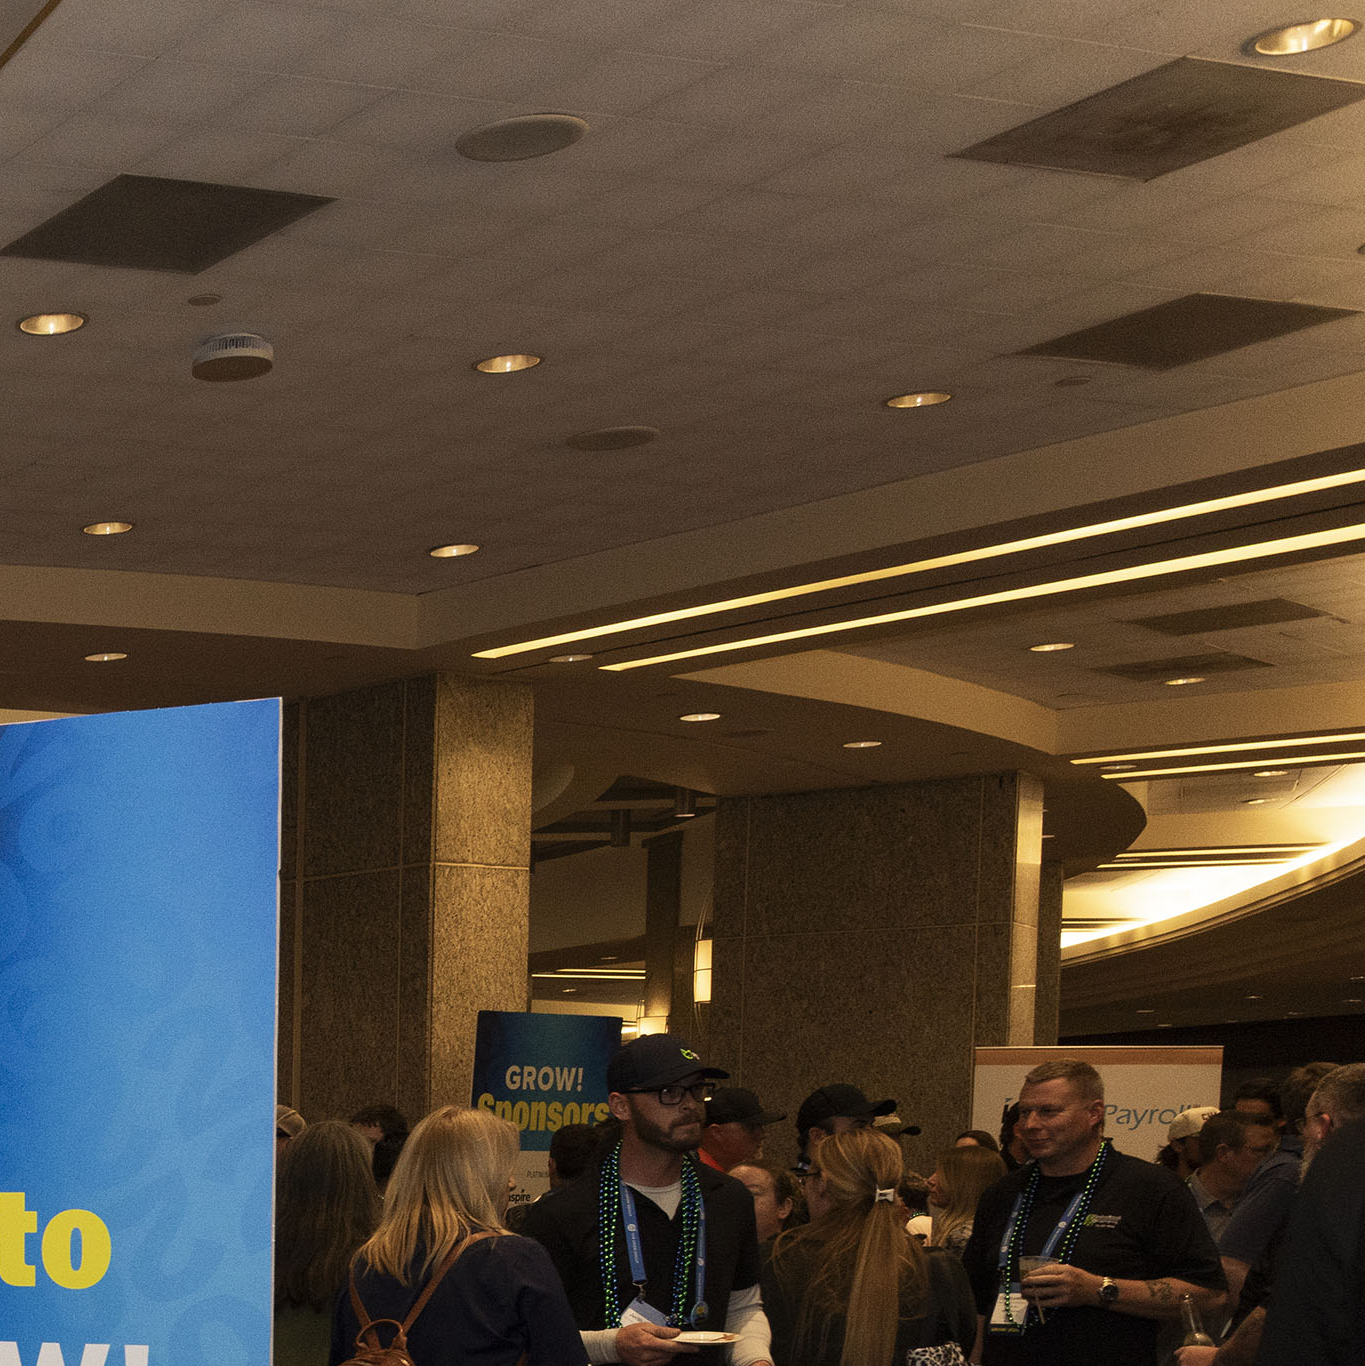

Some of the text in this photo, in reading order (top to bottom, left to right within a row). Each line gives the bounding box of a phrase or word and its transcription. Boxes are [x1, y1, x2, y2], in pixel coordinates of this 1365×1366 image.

[505, 1065, 584, 1092] GROW!
[1104, 1103, 1192, 1131] Payro
[509, 1189, 531, 1204] spire
